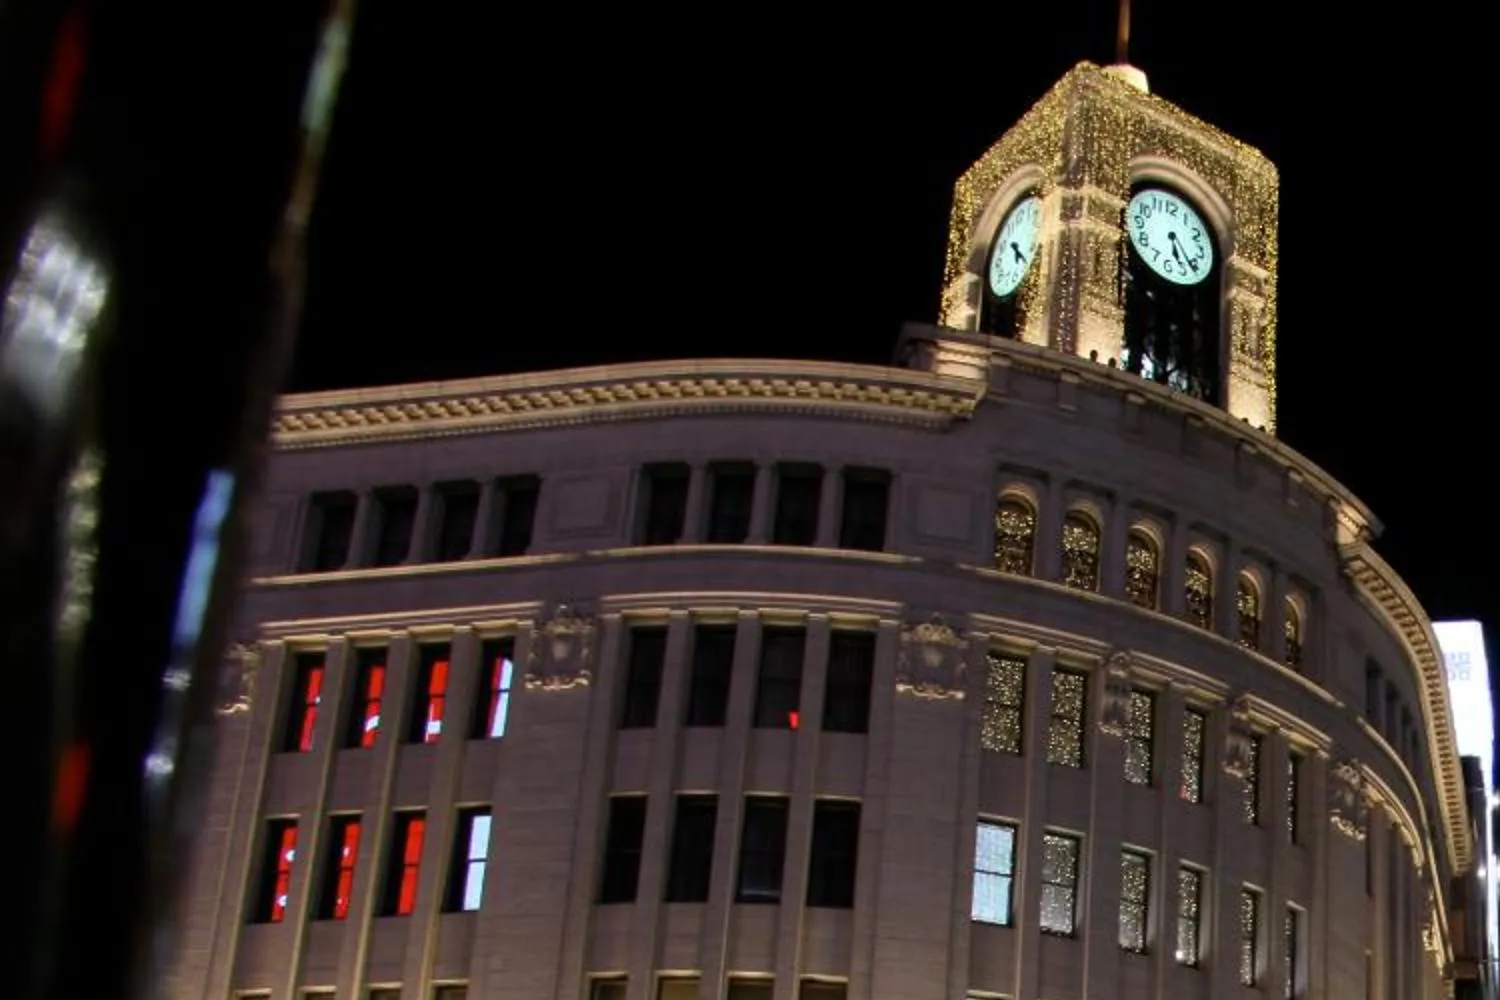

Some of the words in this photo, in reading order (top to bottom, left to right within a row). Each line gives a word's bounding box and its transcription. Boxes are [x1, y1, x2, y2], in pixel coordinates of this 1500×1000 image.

[1139, 203, 1152, 219] 10
[1165, 200, 1179, 217] 12
[1134, 215, 1145, 229] 9
[1191, 227, 1201, 243] 2
[1151, 247, 1161, 262] 7
[1163, 259, 1173, 273] 6
